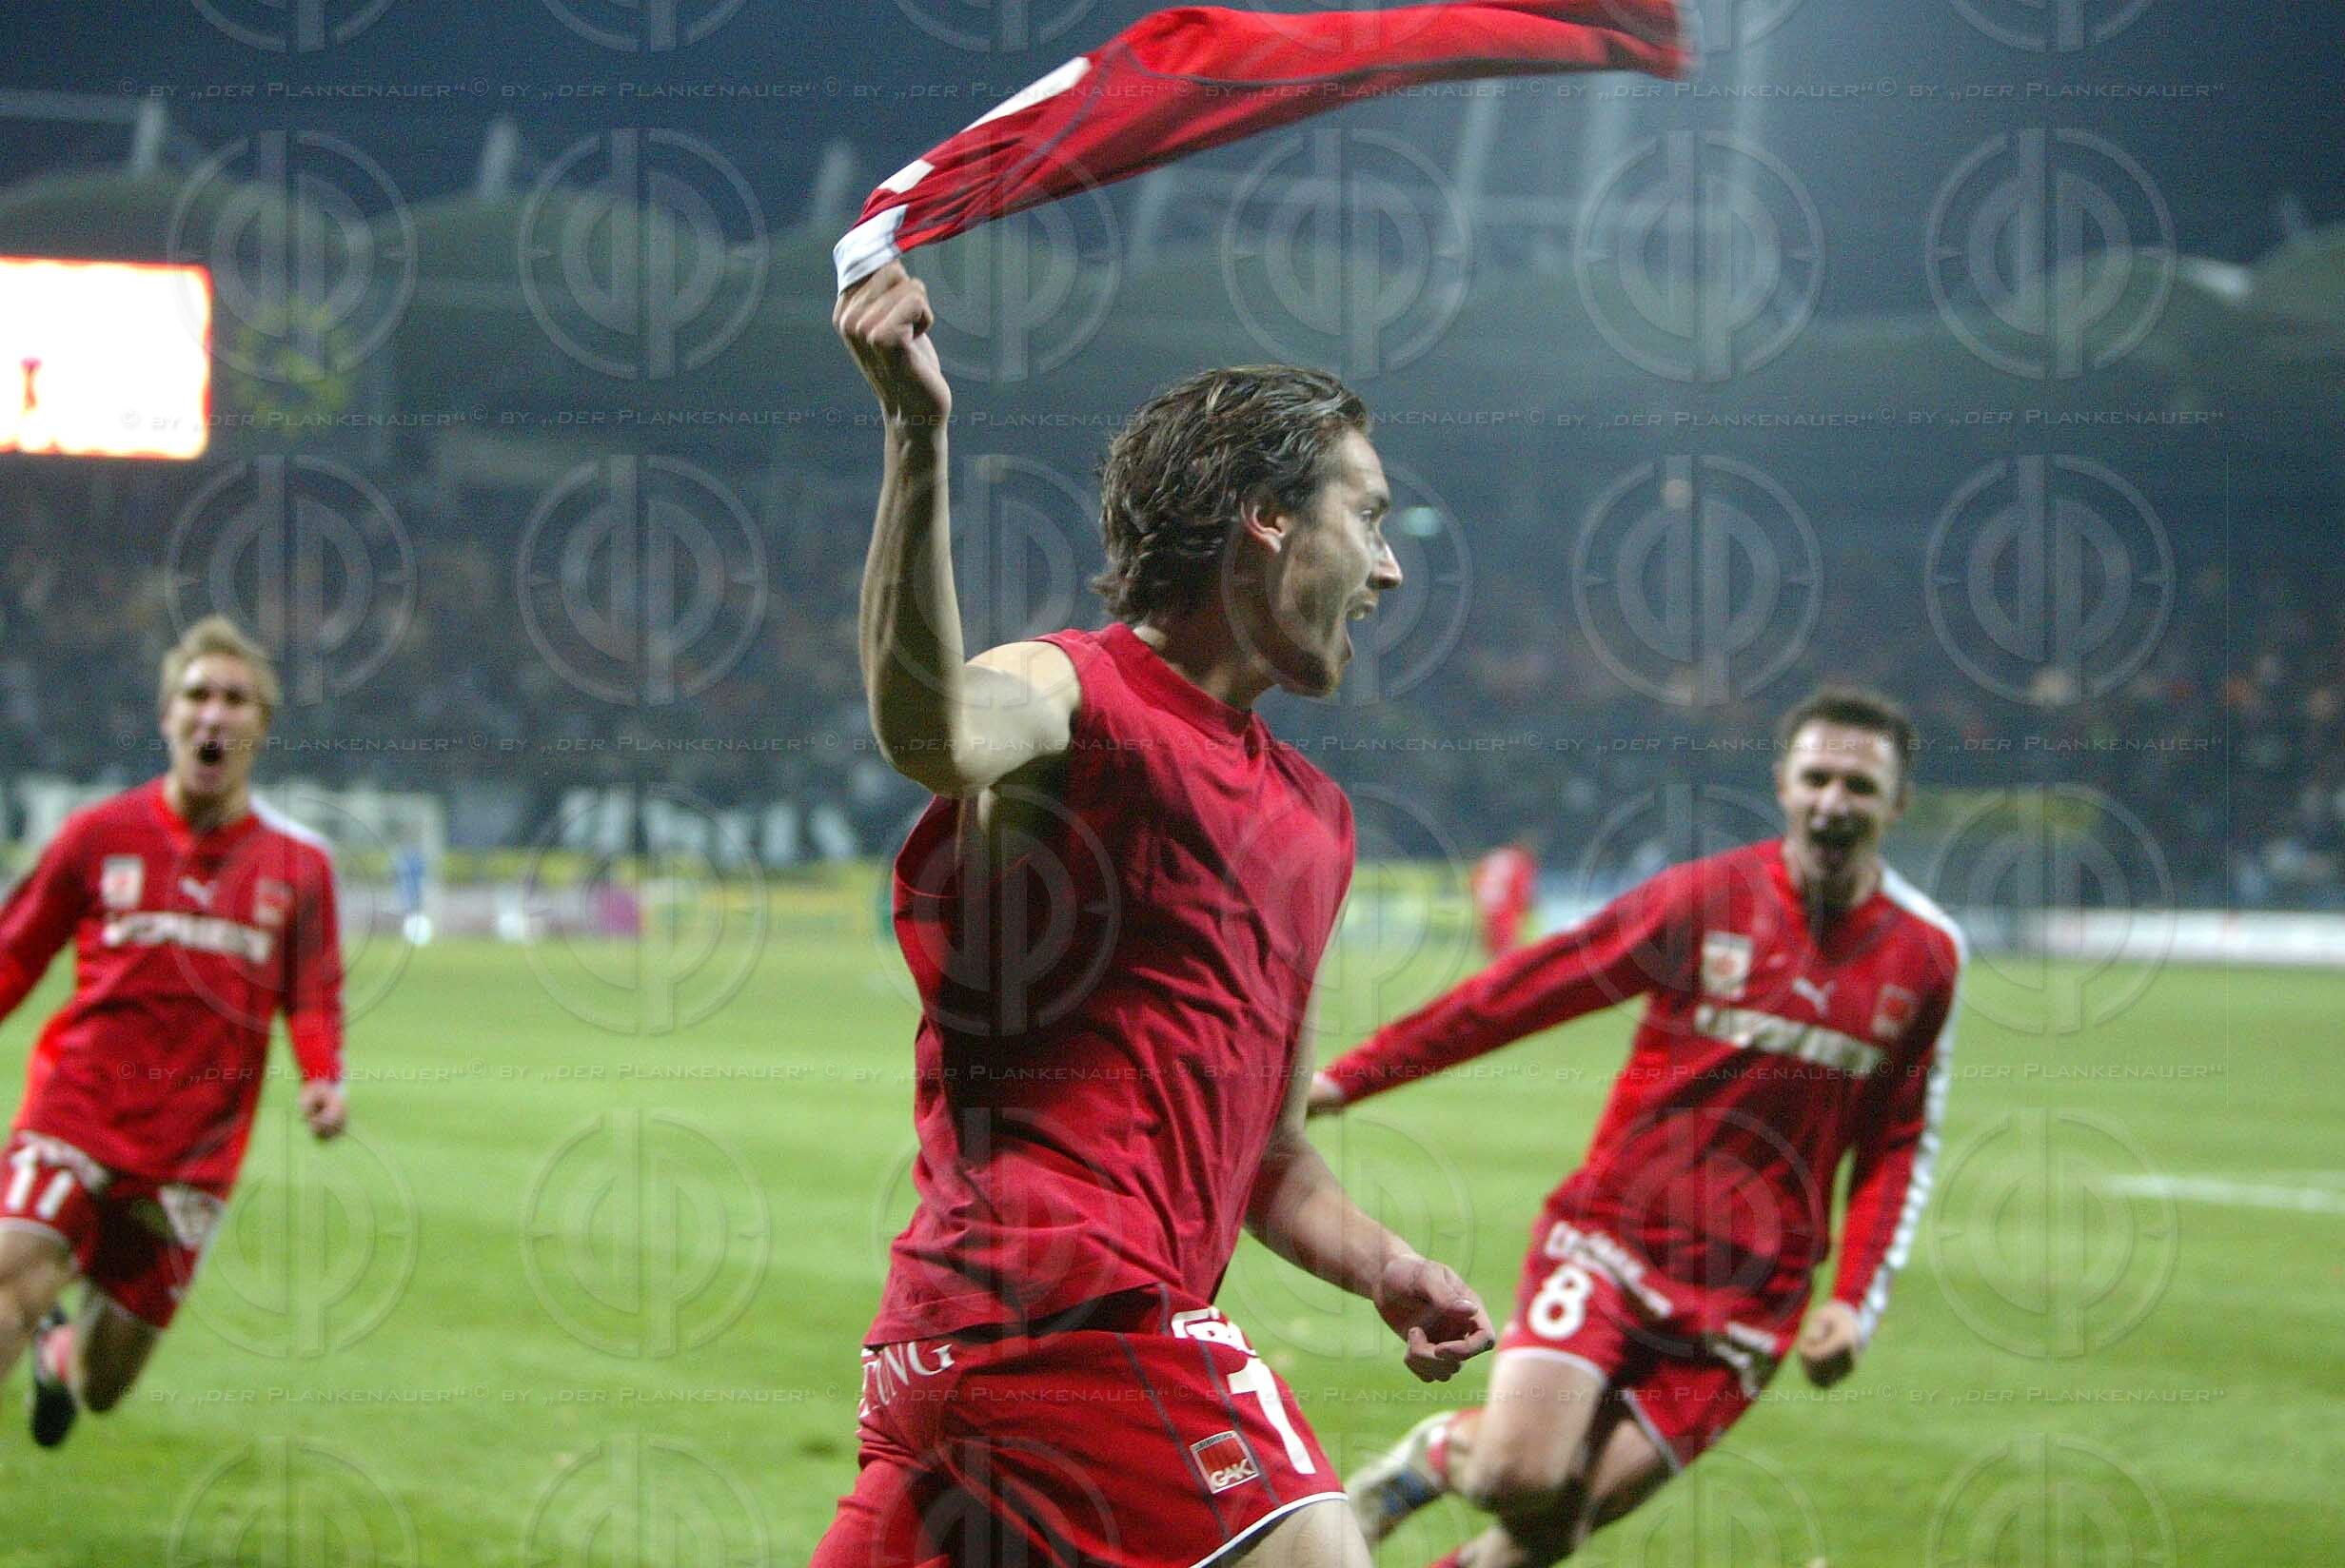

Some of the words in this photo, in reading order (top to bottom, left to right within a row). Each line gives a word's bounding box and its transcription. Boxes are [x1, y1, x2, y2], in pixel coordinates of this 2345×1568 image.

[6, 1145, 76, 1219] 11
[1527, 1263, 1594, 1340] 8
[1210, 1458, 1256, 1487] GAK
